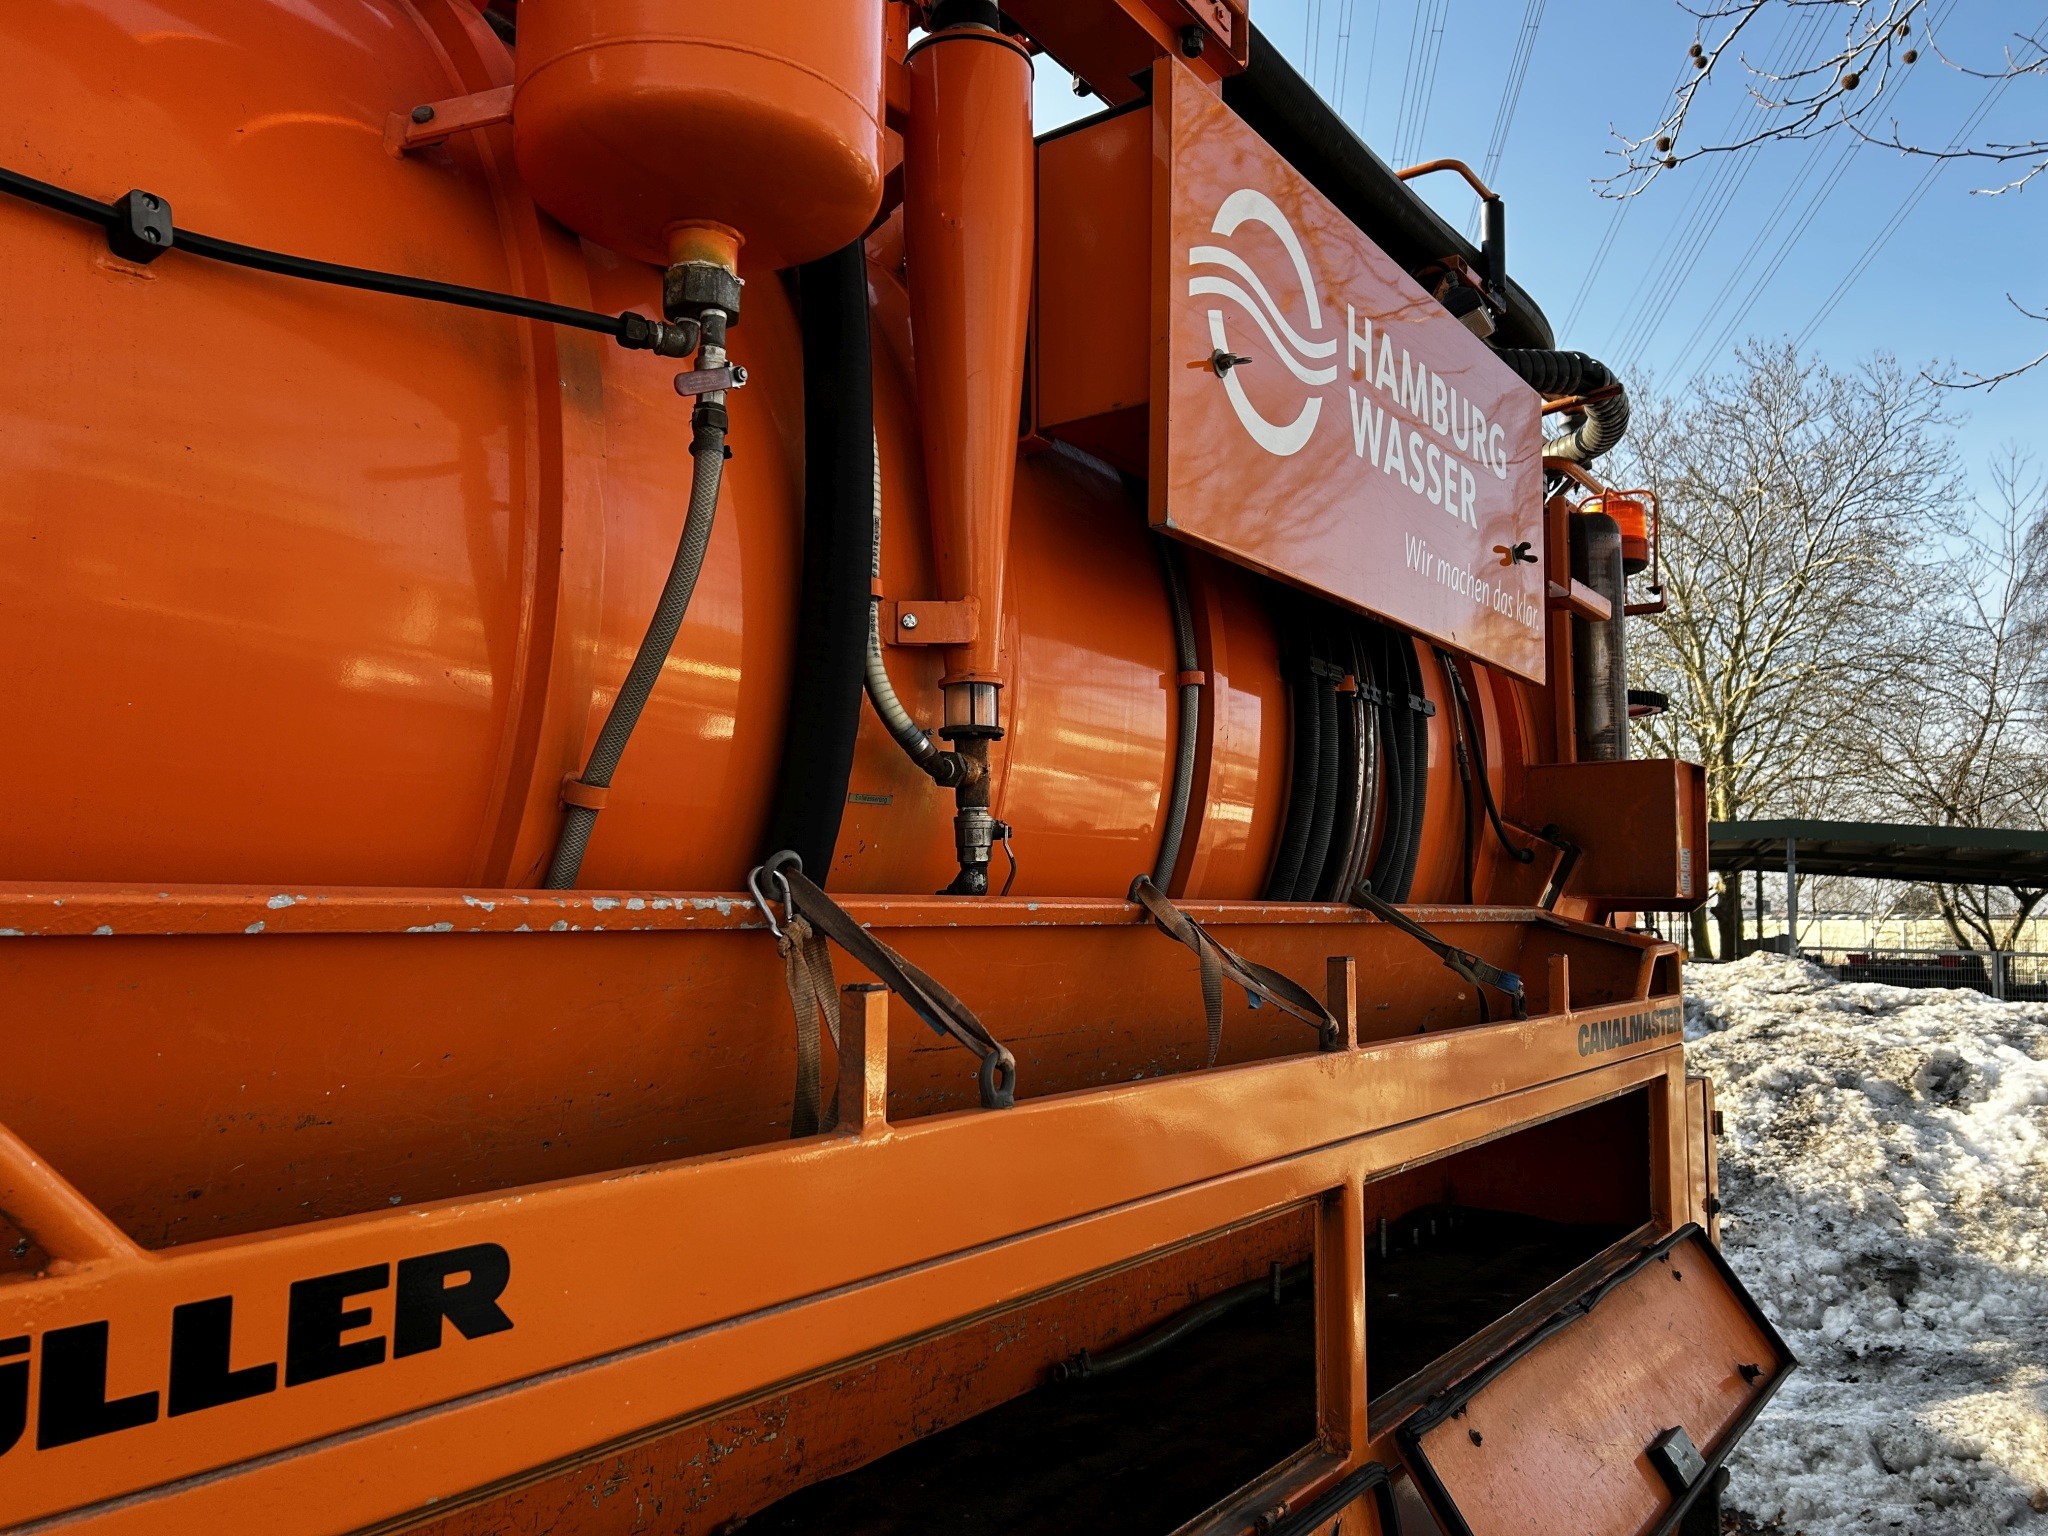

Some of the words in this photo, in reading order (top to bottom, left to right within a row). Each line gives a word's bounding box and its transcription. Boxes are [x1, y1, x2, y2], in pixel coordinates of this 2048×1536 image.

[1347, 302, 1507, 480] HAMBURG
[1348, 385, 1478, 530] WASSER
[1405, 531, 1433, 577] Wir
[1437, 558, 1490, 607] machen
[1493, 579, 1514, 619] das
[1515, 589, 1540, 631] klar.
[1577, 1005, 1682, 1058] CANALMASTER
[0, 1242, 514, 1457] LLER
